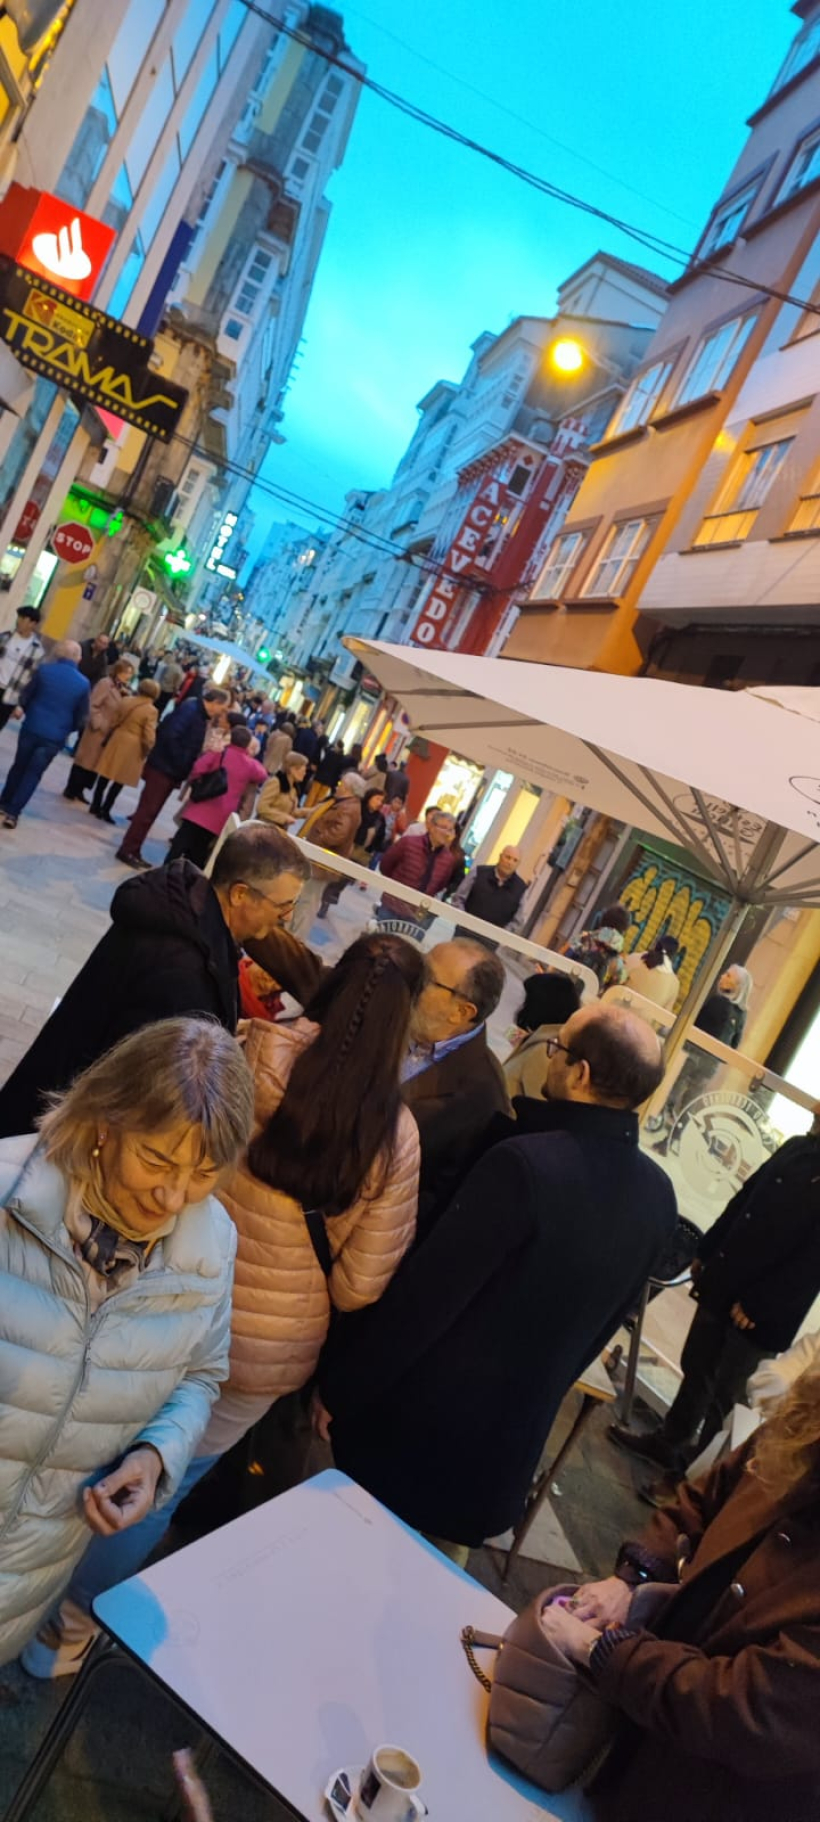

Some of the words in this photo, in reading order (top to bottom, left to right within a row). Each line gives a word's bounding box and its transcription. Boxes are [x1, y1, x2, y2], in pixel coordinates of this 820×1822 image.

[3, 307, 179, 410] TRAMAS
[56, 532, 91, 554] STOP
[206, 513, 237, 570] HOTEL
[417, 481, 500, 643] ACEVEDO
